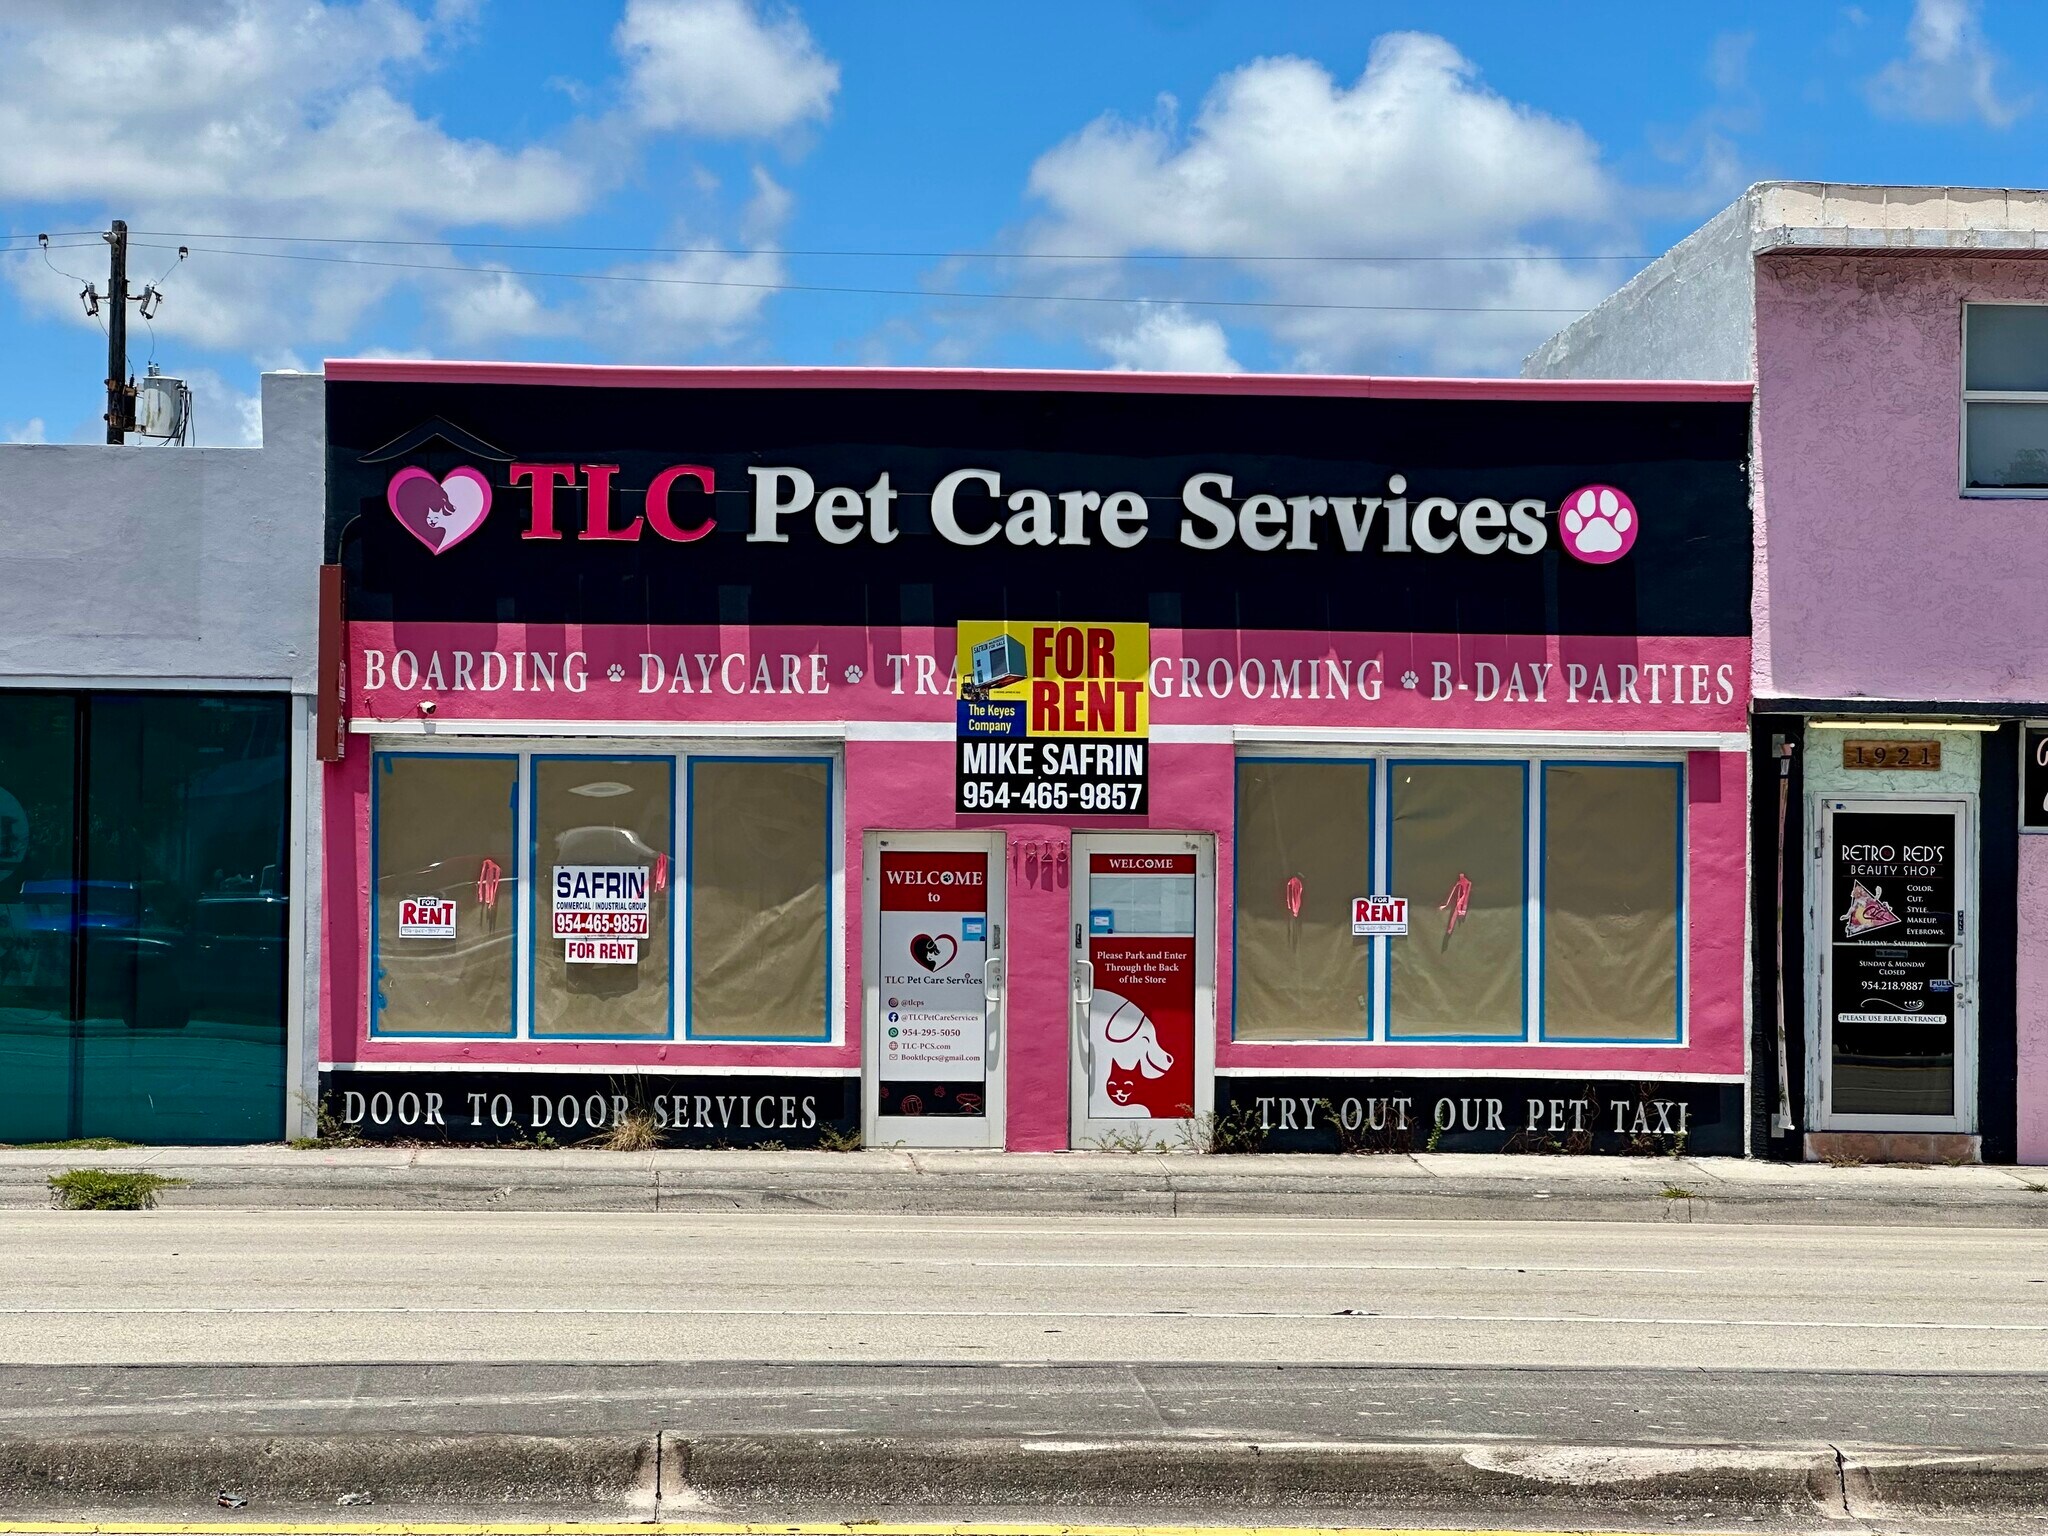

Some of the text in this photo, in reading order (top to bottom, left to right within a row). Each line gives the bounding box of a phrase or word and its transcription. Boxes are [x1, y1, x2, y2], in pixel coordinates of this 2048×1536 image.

[509, 463, 1547, 556] TLC Pet Care Services
[1032, 627, 1115, 679] FOR
[364, 649, 590, 693] BOARDING
[639, 652, 830, 695] DAYCARE
[1149, 656, 1383, 701] GROOMING
[1431, 661, 1734, 704] B-DAY PARTIES
[968, 704, 1016, 719] The Keyes
[1032, 680, 1144, 732] RENT
[968, 718, 1012, 734] Company
[963, 743, 1143, 776] MIKE SAFRIN
[1855, 746, 1930, 765] 1921
[963, 781, 1143, 810] 954-465-9857
[1842, 845, 1945, 862] RETRO RED'S
[1109, 859, 1174, 868] WELCOME
[1850, 865, 1936, 876] BEAUTY SHOP
[556, 871, 645, 899] SAFRIN
[886, 870, 983, 885] WELCOME
[927, 892, 941, 902] to
[402, 902, 454, 925] RENT
[556, 901, 591, 910] COMMERCIAL
[595, 902, 627, 910] INDUSTRIAL
[628, 902, 647, 911] GROUP
[1355, 900, 1406, 922] RENT
[556, 913, 647, 933] 954-465-9857
[568, 943, 635, 960] FOR RENT
[1097, 951, 1187, 960] Please Park and Enter
[1105, 963, 1179, 973] Through the Back
[885, 974, 983, 985] TLC Pet Care Services
[1119, 975, 1167, 984] of the Store
[1861, 980, 1924, 991] 954.218.9887
[901, 998, 925, 1008] @tlcps
[901, 1013, 979, 1022] @TLCPetCareServices
[1842, 1014, 1866, 1022] PLEASE
[1903, 1015, 1942, 1023] ENTRANCE
[902, 1028, 961, 1037] 954-295-5050
[901, 1042, 951, 1050] TLC-PCS.com
[901, 1053, 981, 1063] Booktlcpcs@gmail.com
[344, 1091, 817, 1129] DOOR TO DOOR SERVICES
[1256, 1096, 1689, 1135] TRY OUT OUR PET TAXI
